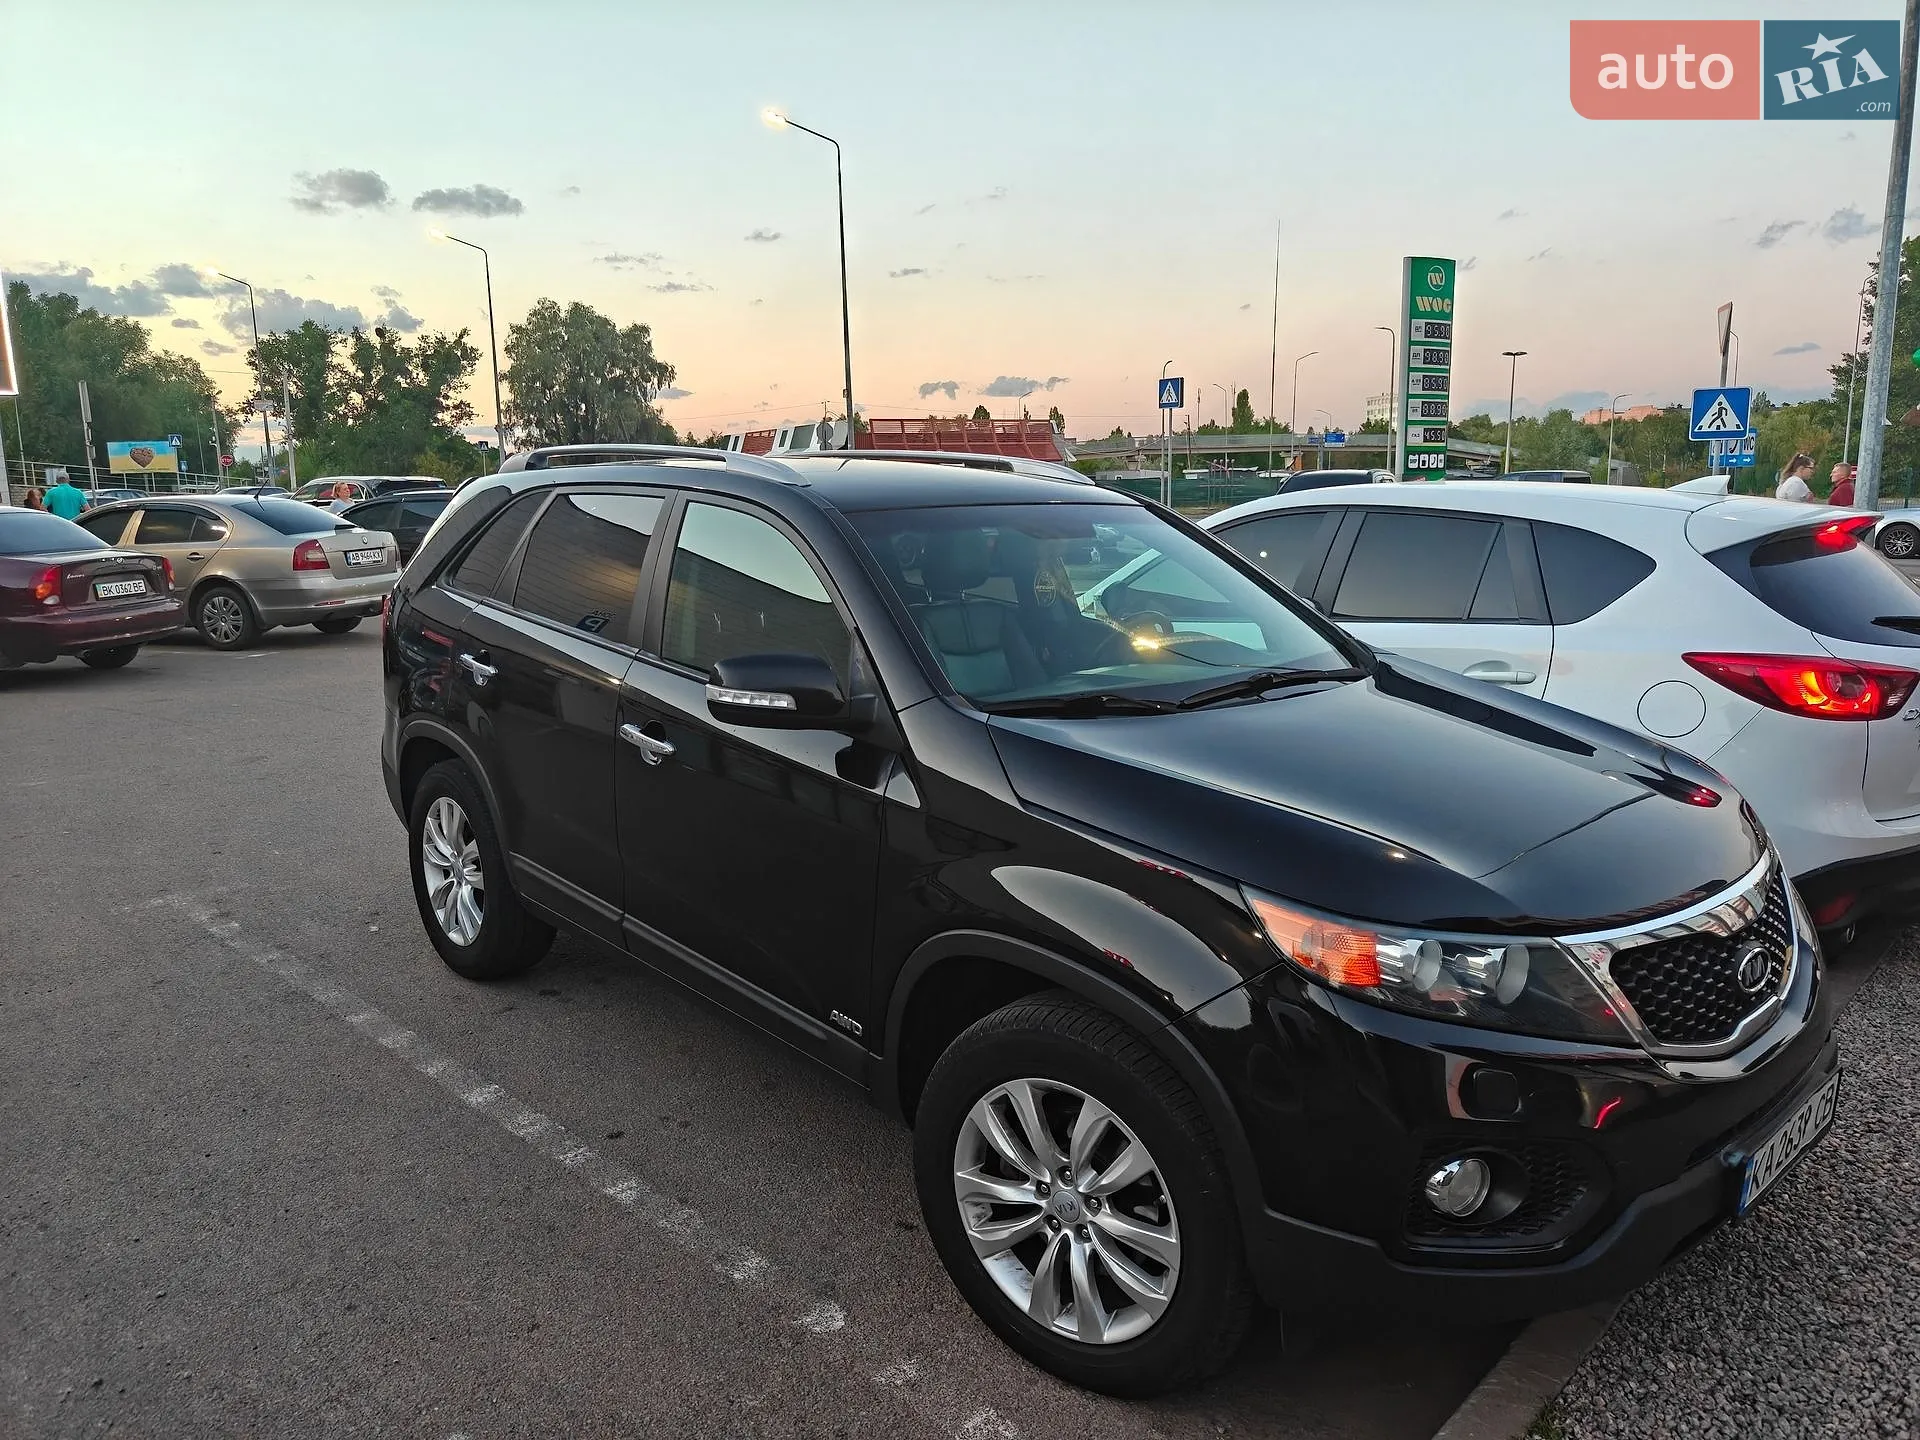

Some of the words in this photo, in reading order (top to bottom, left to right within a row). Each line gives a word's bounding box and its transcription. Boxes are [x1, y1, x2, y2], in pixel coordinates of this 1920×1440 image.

[1416, 296, 1452, 313] WOG
[102, 584, 114, 596] BK
[115, 583, 132, 595] 0362
[133, 581, 145, 592] BE
[829, 1009, 863, 1037] AWD
[1750, 1143, 1775, 1190] KA
[1814, 1083, 1835, 1130] CB
